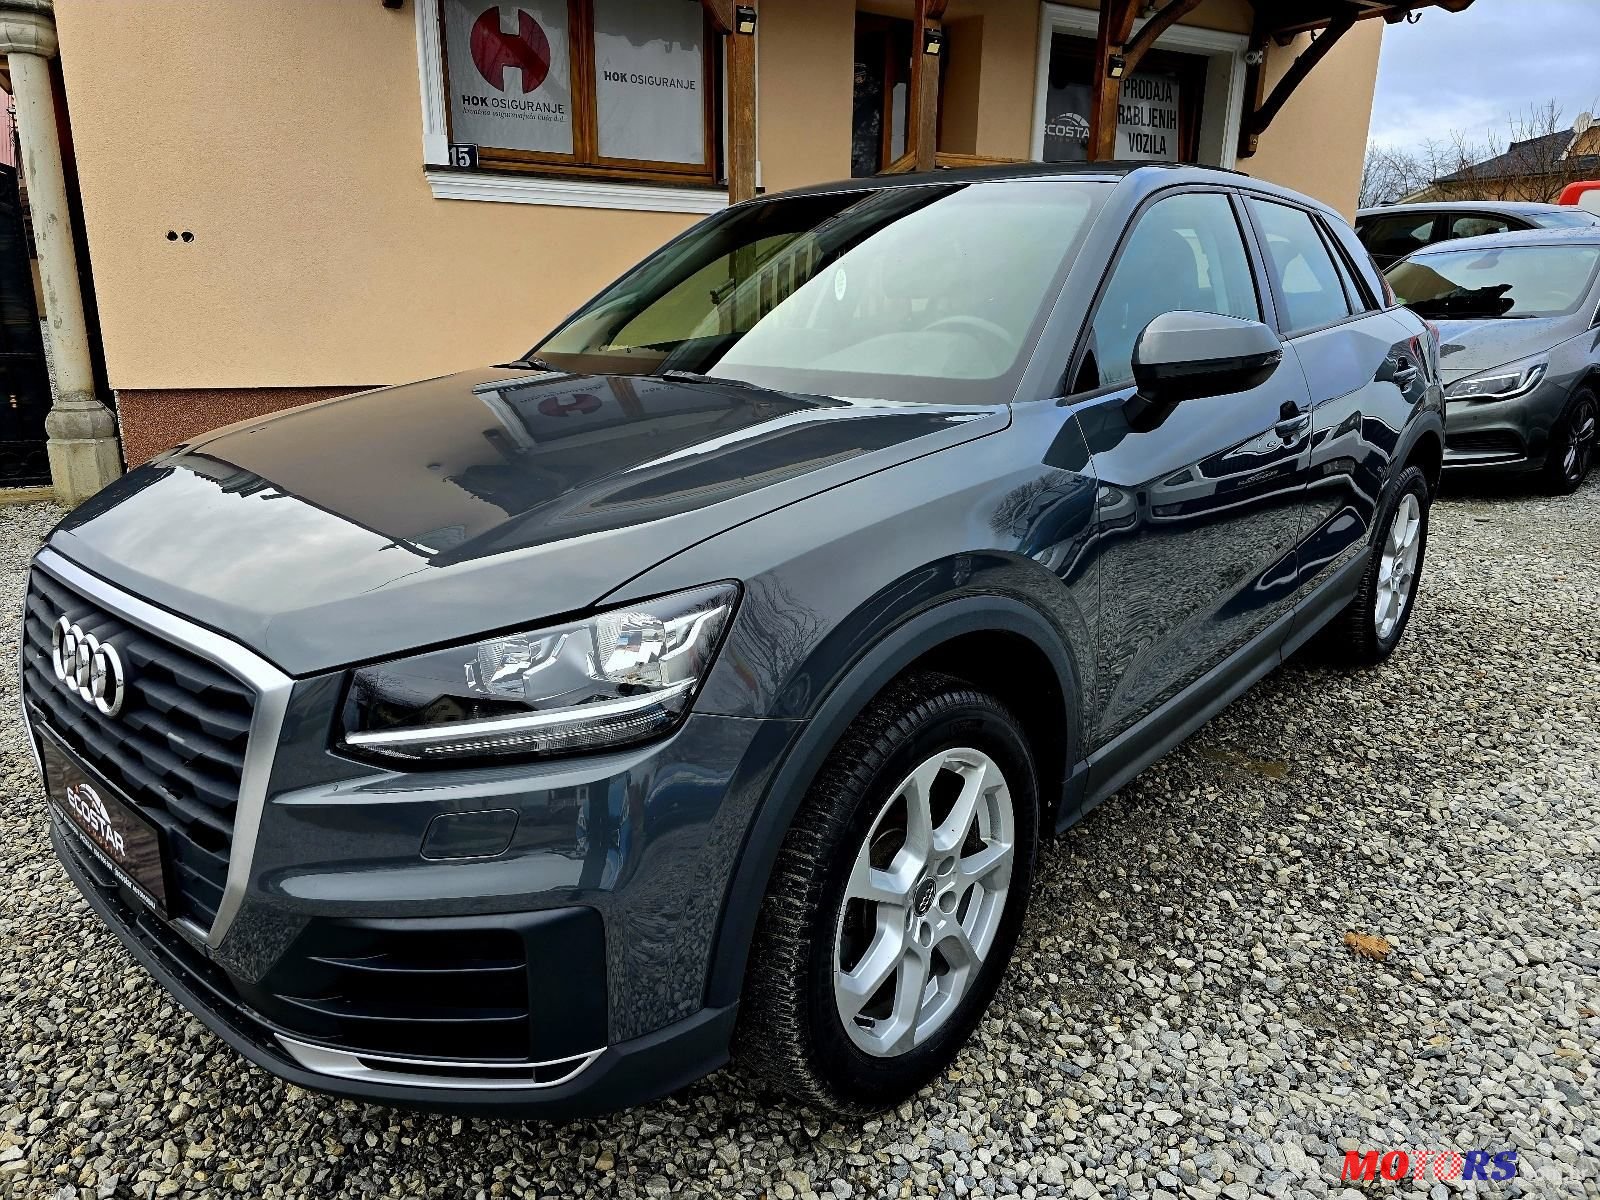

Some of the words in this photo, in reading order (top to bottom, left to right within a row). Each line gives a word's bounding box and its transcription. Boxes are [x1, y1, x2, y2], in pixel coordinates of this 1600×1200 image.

[603, 70, 628, 83] HOK
[630, 74, 696, 90] OSIGURANJE
[1123, 78, 1173, 103] PRODAJA
[462, 94, 489, 107] HOK
[491, 97, 565, 114] OSIGURANJE
[1118, 104, 1177, 129] RABLJENIH
[1044, 124, 1090, 138] COSTA
[1128, 132, 1167, 155] VOZILA
[450, 146, 470, 167] 15
[66, 786, 126, 857] ECOSTAR
